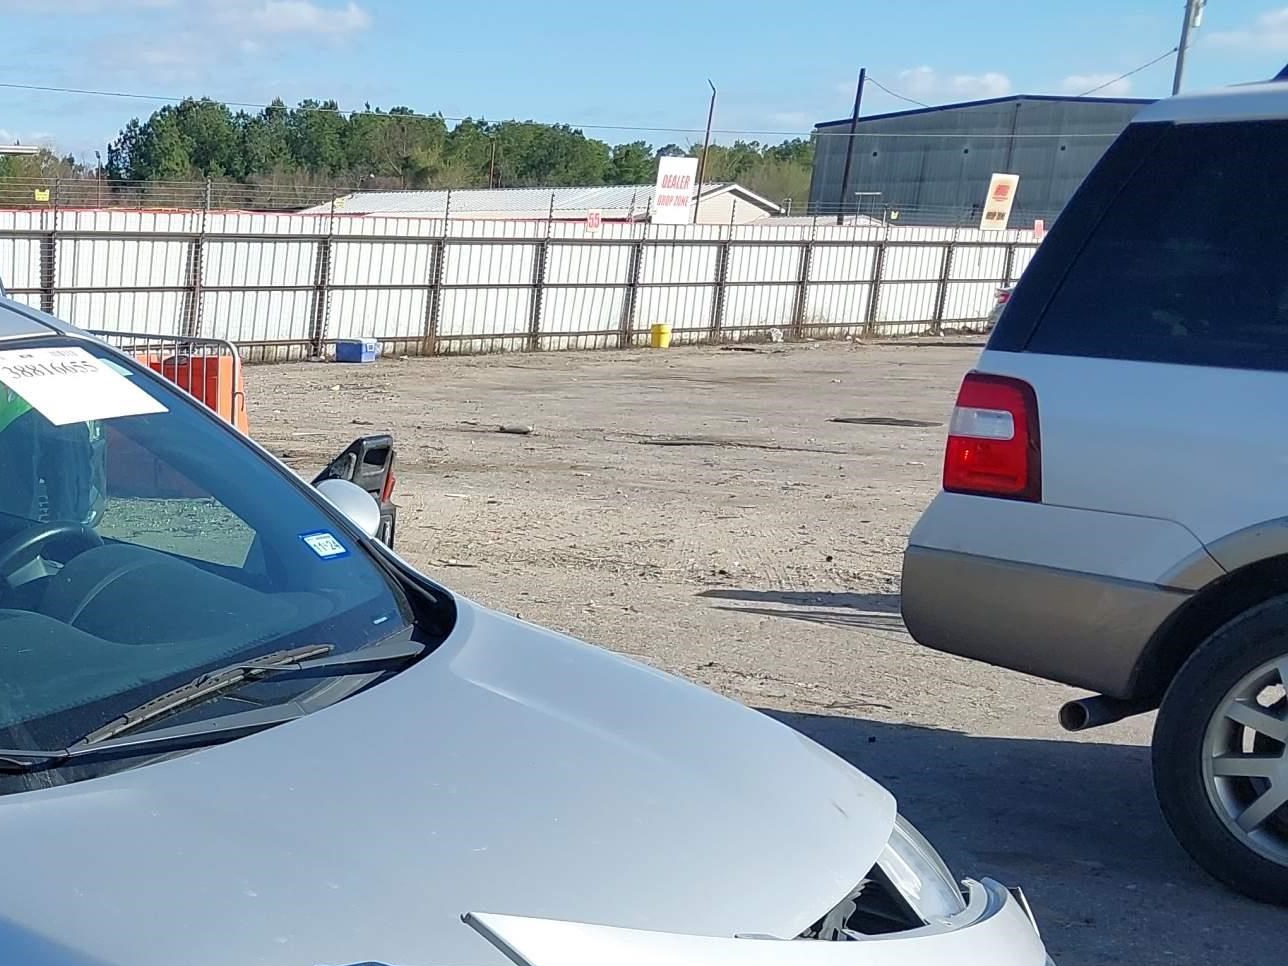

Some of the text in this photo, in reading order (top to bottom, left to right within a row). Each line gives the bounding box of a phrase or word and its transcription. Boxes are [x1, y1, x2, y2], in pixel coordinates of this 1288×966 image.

[661, 174, 691, 190] DEALER
[673, 195, 689, 207] ZONE
[588, 212, 600, 229] 55
[1, 360, 99, 379] 38816655
